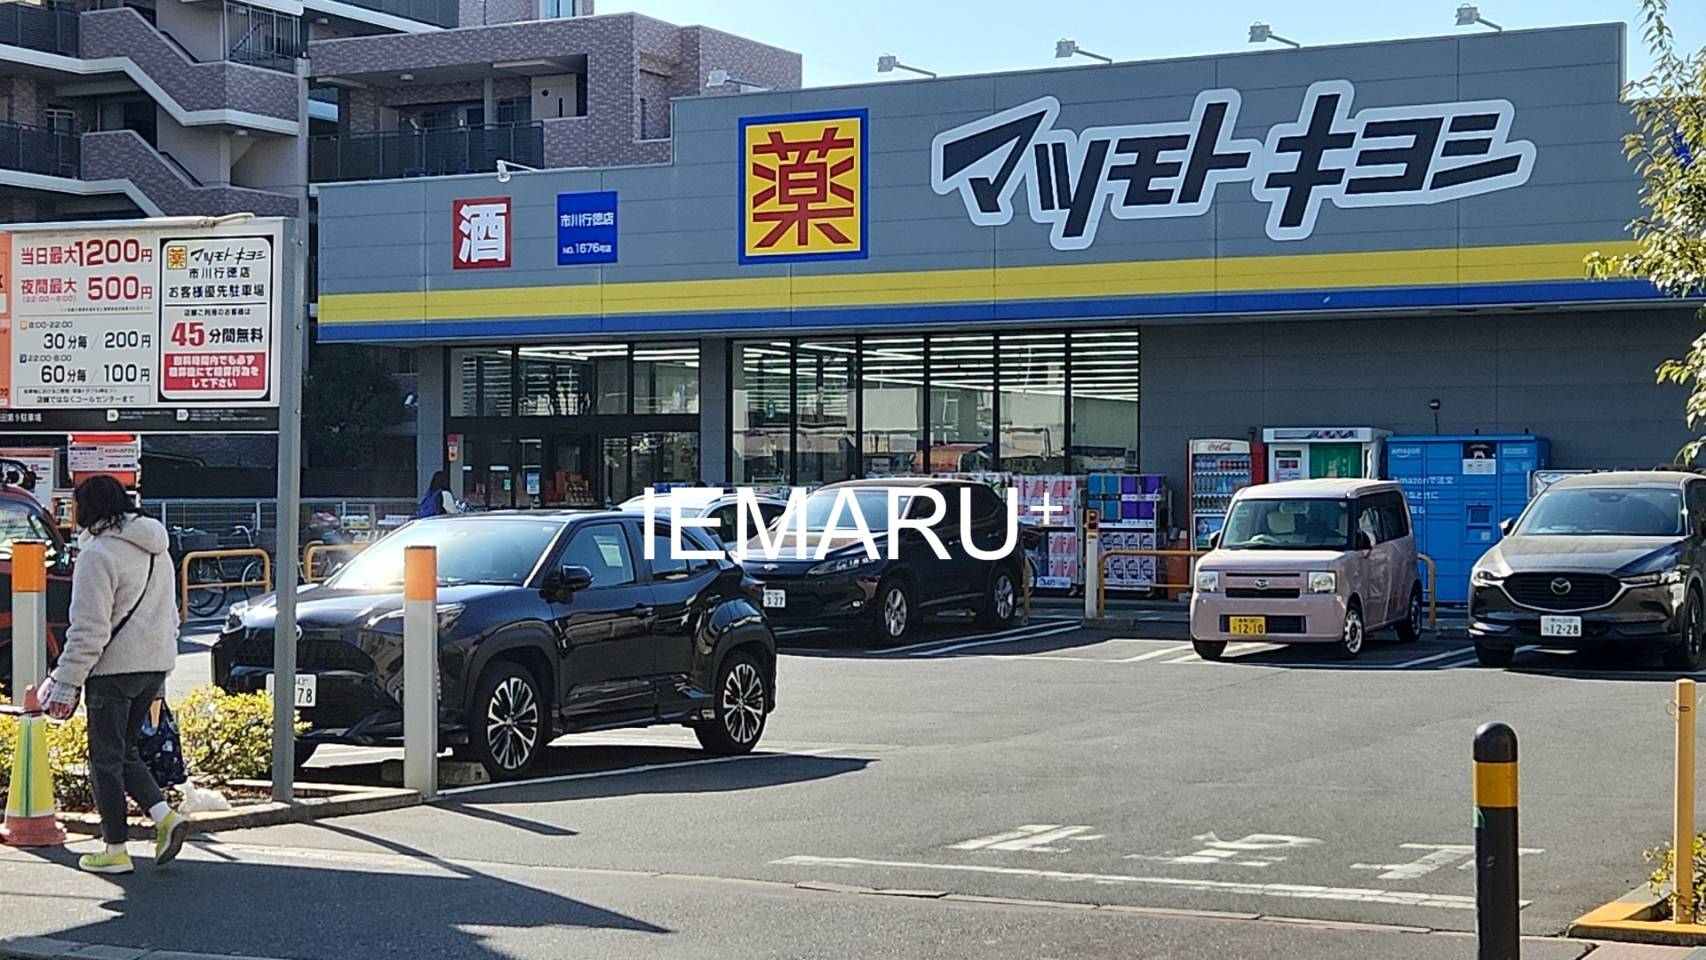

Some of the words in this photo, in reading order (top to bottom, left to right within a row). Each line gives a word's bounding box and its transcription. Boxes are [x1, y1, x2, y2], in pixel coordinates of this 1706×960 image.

[938, 86, 1530, 244] マツモトキヨシ
[752, 126, 855, 249] 薬
[560, 211, 615, 228] 市川行徳店
[458, 203, 508, 263] 酒
[190, 246, 267, 266] マツモトキヨシ
[188, 266, 251, 280] 市川行徳店
[168, 284, 265, 299] お客様優先駐車場
